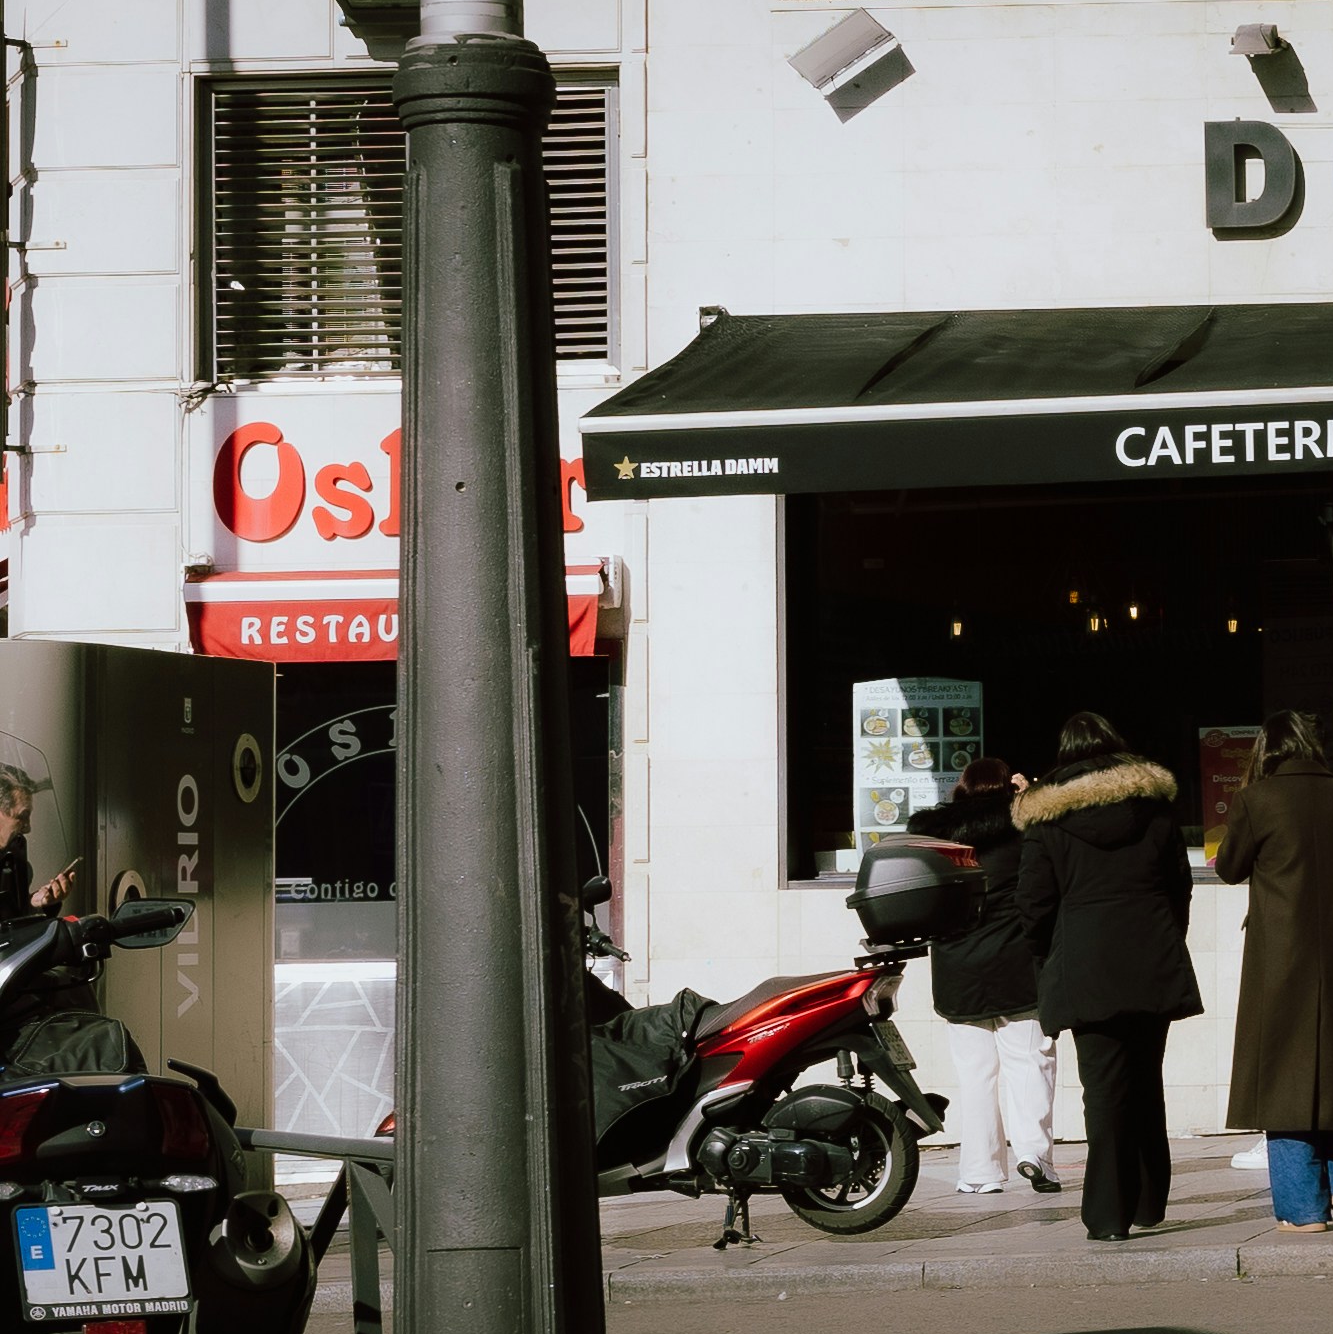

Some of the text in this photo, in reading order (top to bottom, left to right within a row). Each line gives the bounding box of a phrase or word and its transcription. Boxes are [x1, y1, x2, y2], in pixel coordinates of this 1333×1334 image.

[640, 457, 779, 478] ESTRELLA DAMM
[212, 420, 587, 543] Osr
[240, 613, 399, 645] RESTAU
[1212, 774, 1243, 783] Discov
[62, 1212, 172, 1254] 7302
[30, 1245, 44, 1260] E
[65, 1255, 149, 1296] KFM
[52, 1301, 189, 1318] YAMAHA MOTOR MADRID
